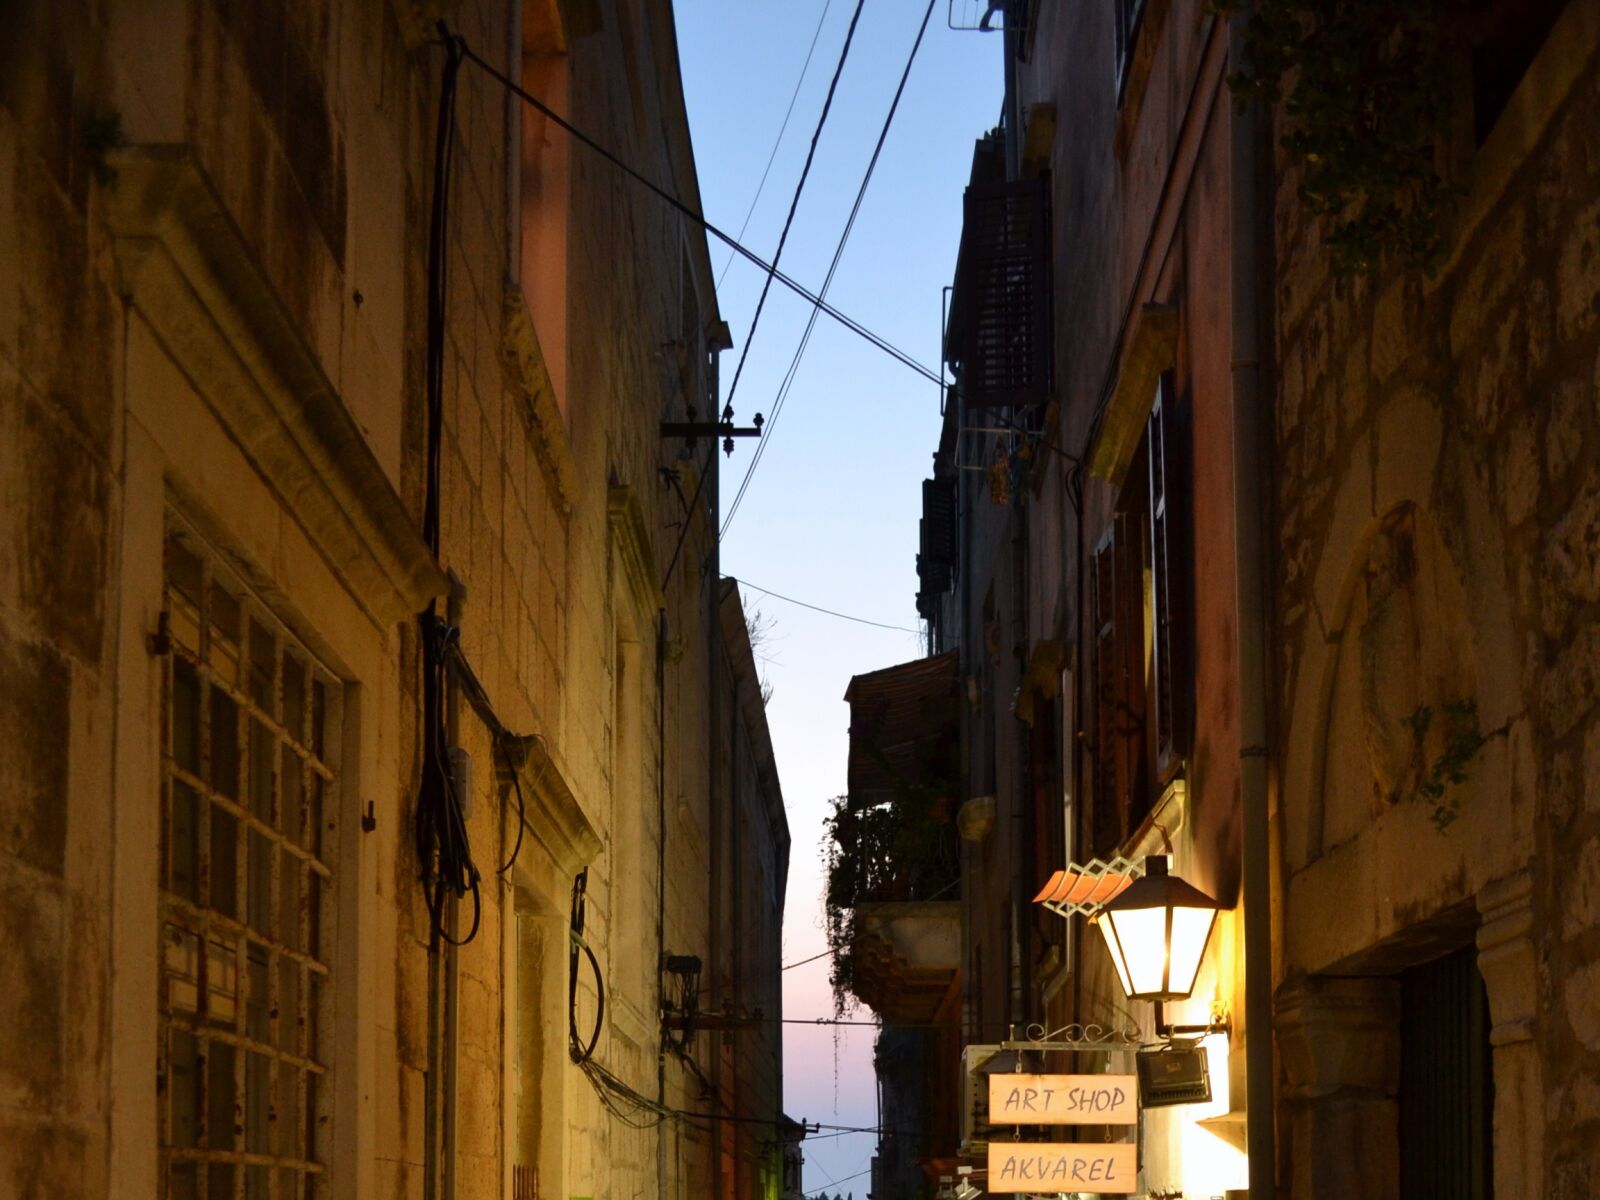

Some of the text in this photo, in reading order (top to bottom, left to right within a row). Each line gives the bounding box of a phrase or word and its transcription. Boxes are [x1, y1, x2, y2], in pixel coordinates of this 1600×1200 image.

[1004, 1087, 1126, 1114] ART SHOP
[1000, 1155, 1116, 1183] AKVAREL
